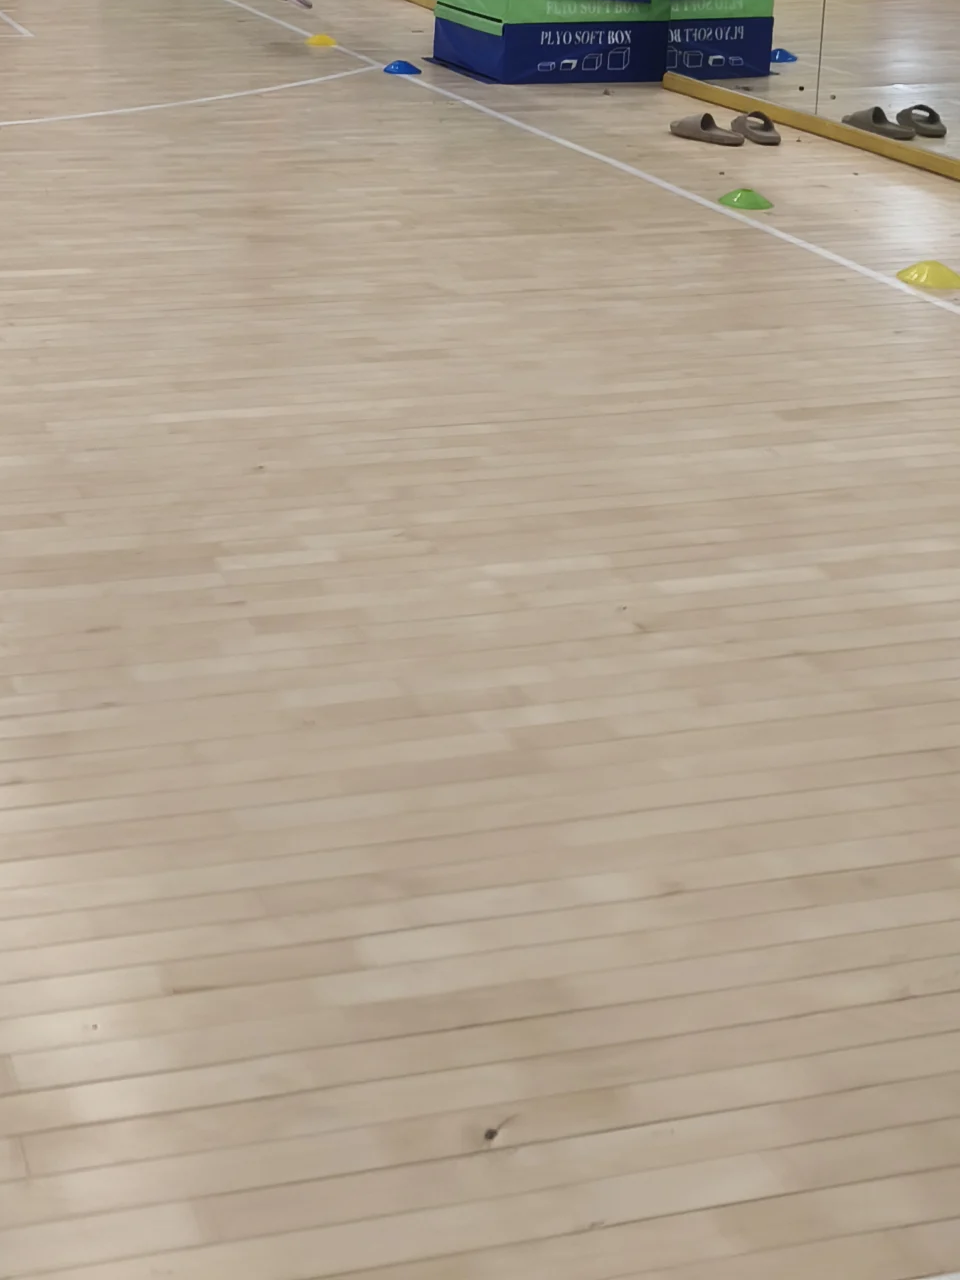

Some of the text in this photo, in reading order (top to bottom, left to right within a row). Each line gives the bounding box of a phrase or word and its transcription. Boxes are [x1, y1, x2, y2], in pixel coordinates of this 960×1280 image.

[540, 29, 632, 45] PLYO SOFT BOX
